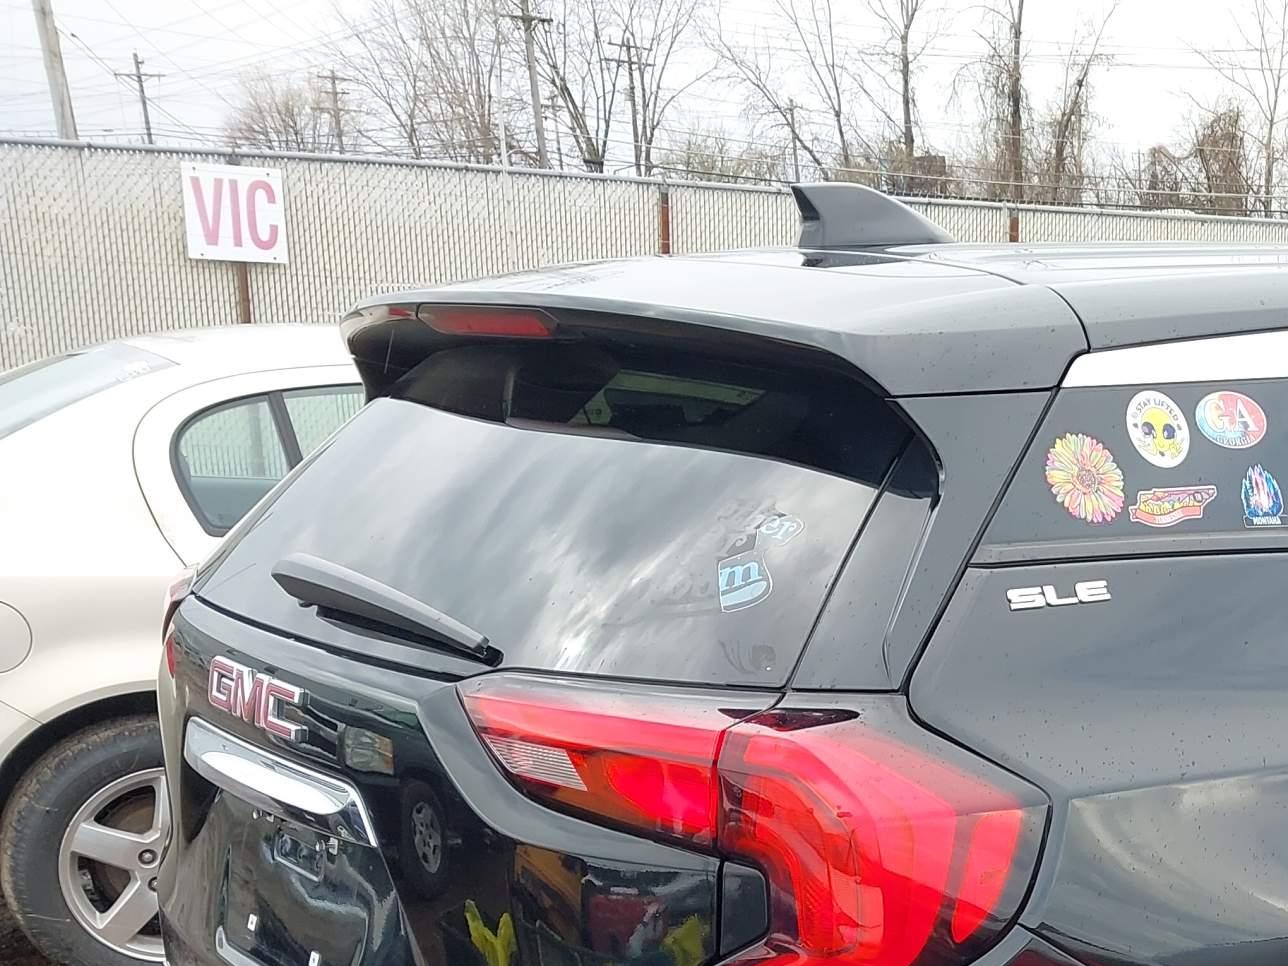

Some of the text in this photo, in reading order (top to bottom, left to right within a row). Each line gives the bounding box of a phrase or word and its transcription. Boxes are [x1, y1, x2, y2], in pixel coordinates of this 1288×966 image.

[189, 175, 279, 250] VIC
[1135, 398, 1179, 421] STAY LIFTED
[1205, 399, 1258, 433] GA
[1216, 432, 1257, 447] GEORGIA
[1006, 580, 1112, 611] SLE
[208, 655, 310, 741] GMC
